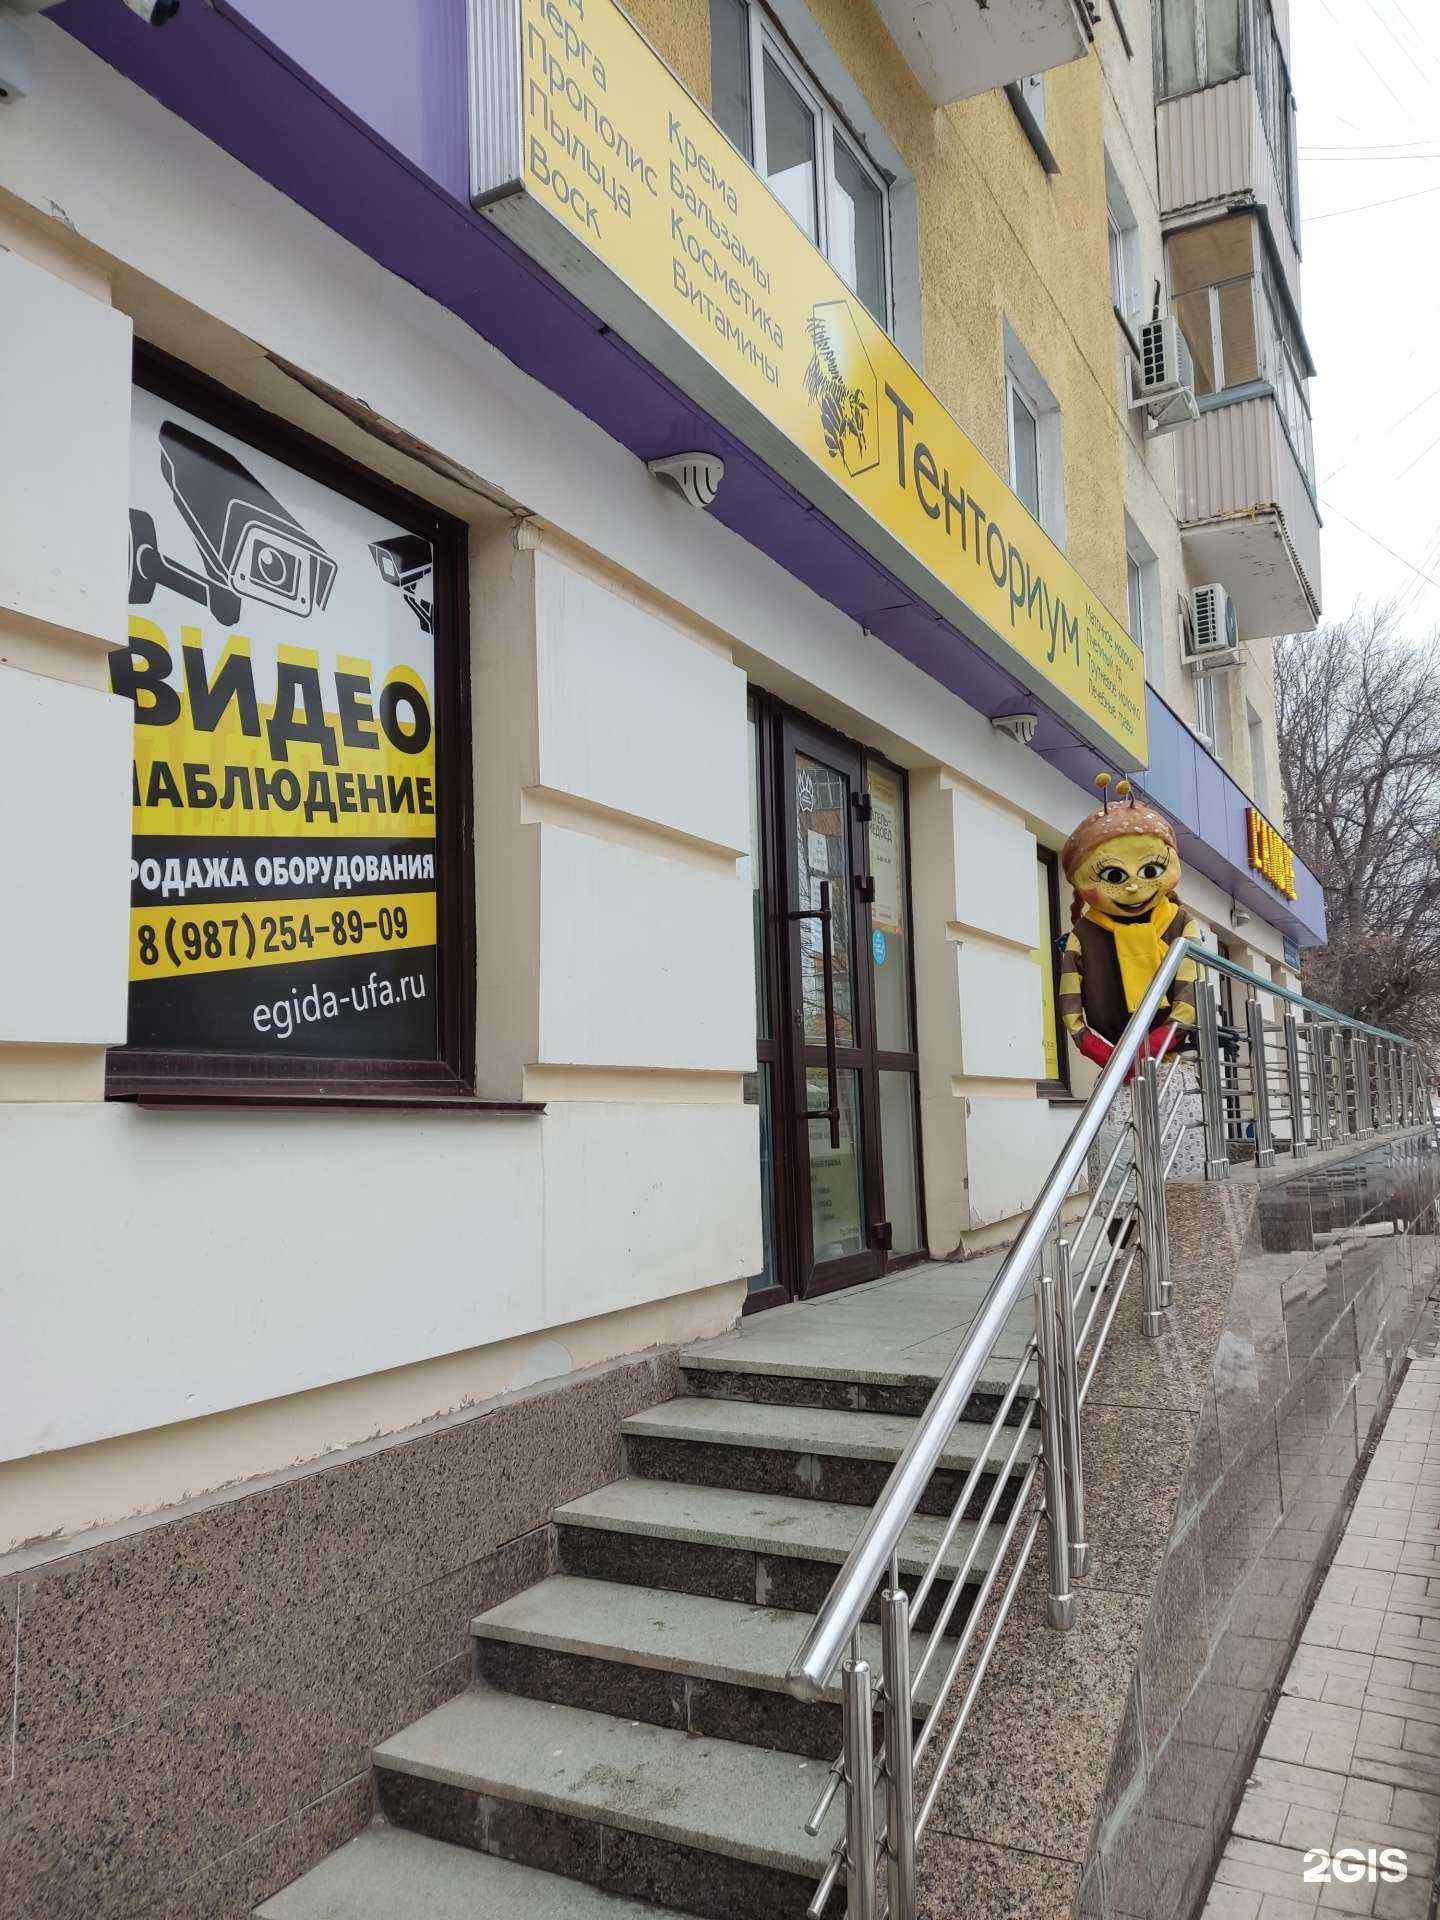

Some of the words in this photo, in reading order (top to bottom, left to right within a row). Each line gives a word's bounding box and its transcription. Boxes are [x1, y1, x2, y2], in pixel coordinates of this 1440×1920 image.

[528, 20, 659, 198] Прополис
[530, 78, 632, 219] Пыльца
[668, 111, 738, 215] Крема
[530, 137, 601, 239] Воск
[669, 159, 771, 294] Бальзамы
[671, 208, 784, 350] Косметика
[672, 257, 779, 388] Витамины
[884, 380, 1080, 667] Тенториум
[108, 635, 432, 766] ВИДЕО
[132, 759, 435, 823] АБЛЮДЕНИЕ
[138, 907, 408, 968] 8(987)254-89-09
[254, 853, 435, 891] ОБОРУДОВАНИЯ
[252, 971, 427, 1039] egida-ufa.ru
